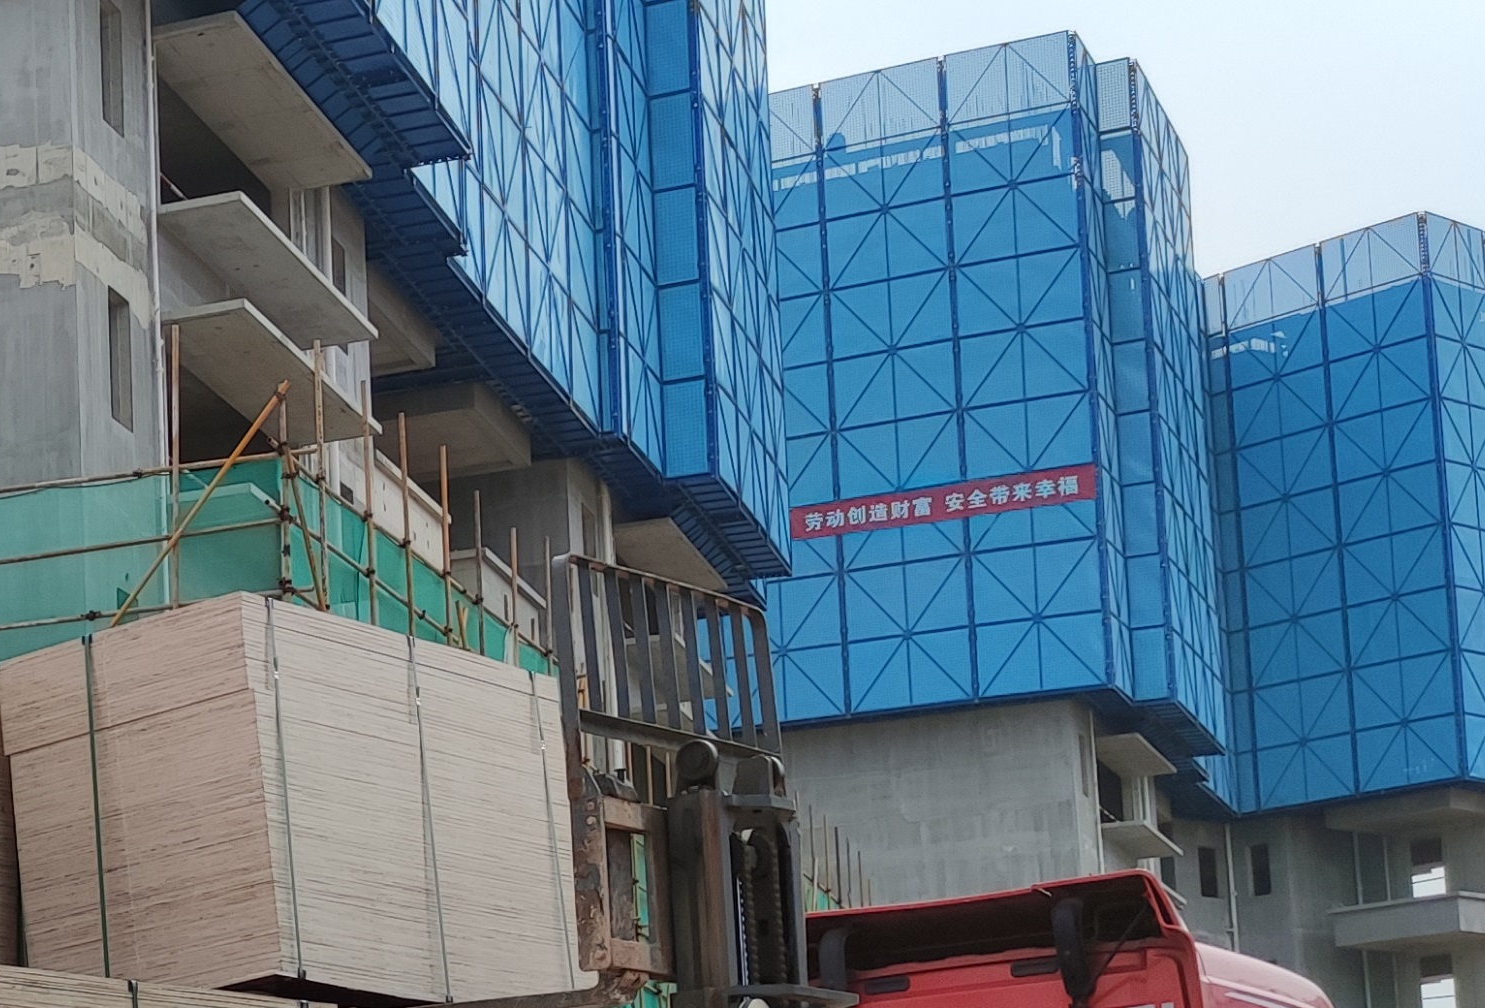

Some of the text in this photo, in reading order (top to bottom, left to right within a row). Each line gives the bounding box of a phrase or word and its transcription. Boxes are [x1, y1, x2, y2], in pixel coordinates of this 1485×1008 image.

[804, 475, 1079, 532] 劳动创造财富 安全带来幸福
